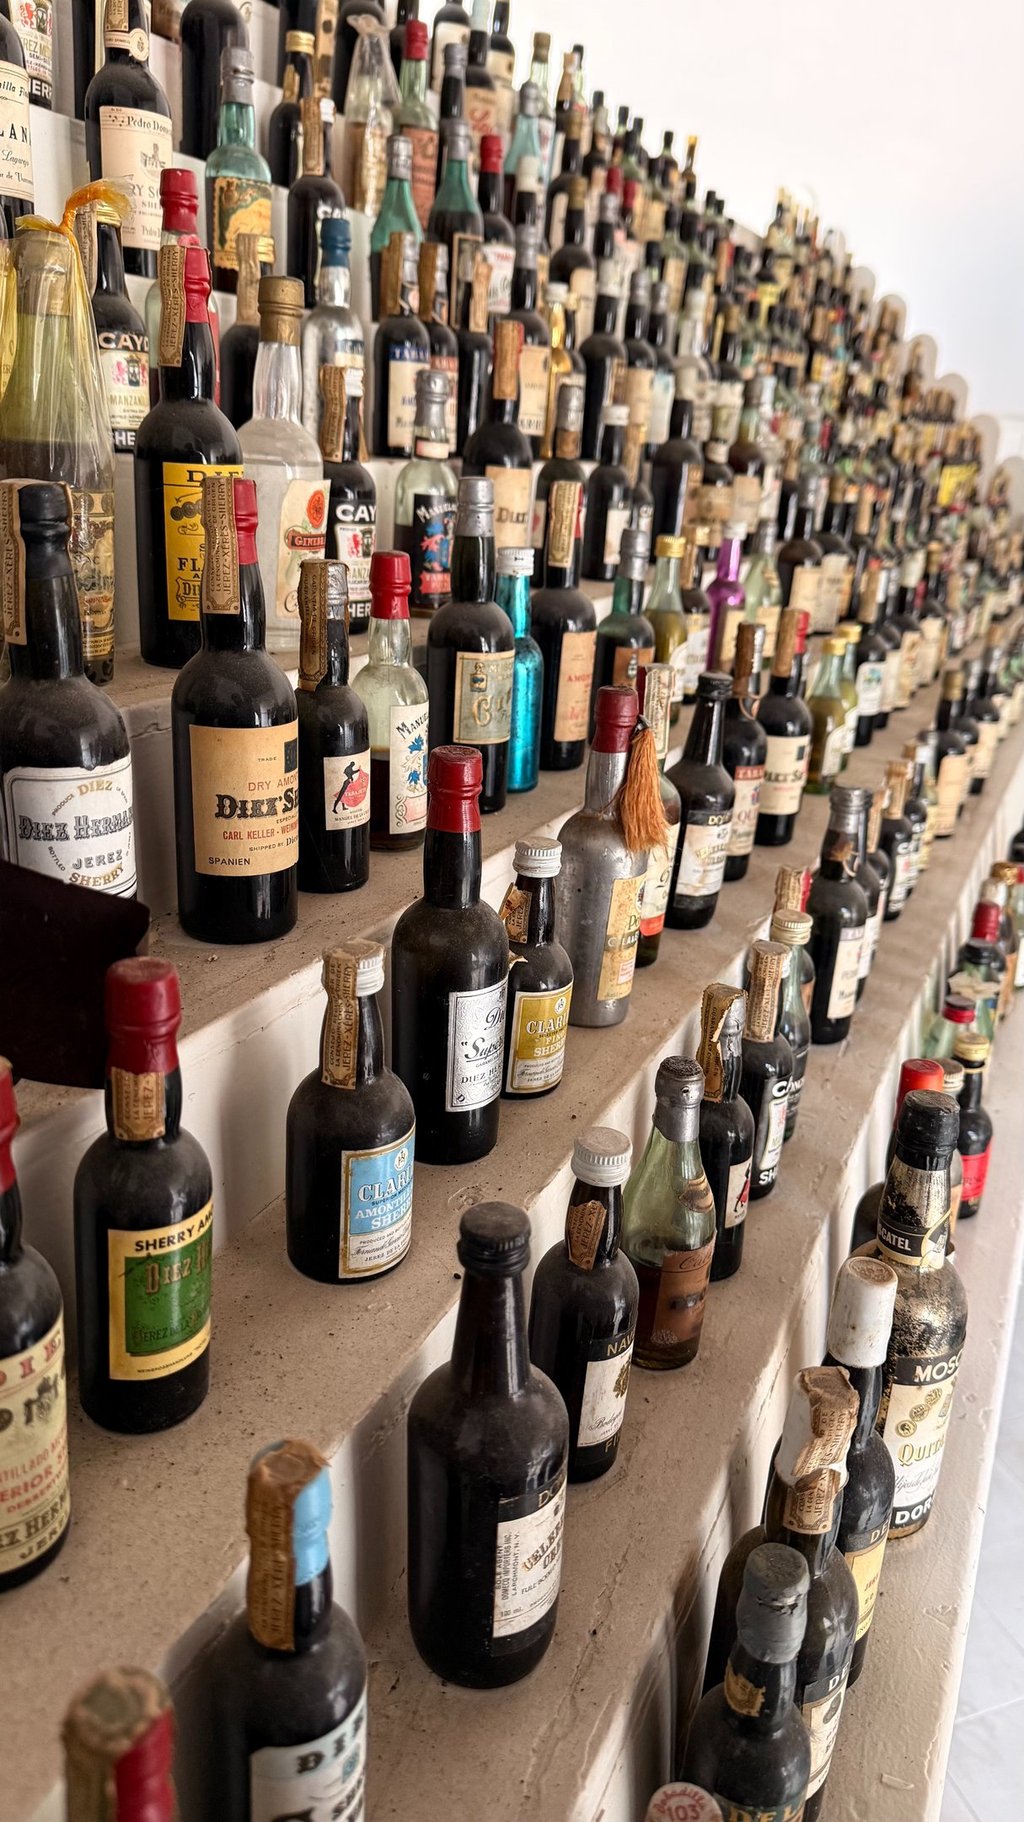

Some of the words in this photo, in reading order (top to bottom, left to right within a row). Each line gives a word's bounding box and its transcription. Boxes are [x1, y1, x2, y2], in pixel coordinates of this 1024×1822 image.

[127, 115, 151, 130] Pedro
[77, 780, 114, 796] DIEZ
[248, 780, 272, 792] DRY
[19, 815, 70, 841] DIEZ
[223, 831, 244, 841] CARL
[247, 828, 275, 840] KELLER
[249, 843, 277, 852] SHIPPED
[72, 849, 123, 870] JEREZ
[208, 857, 251, 866] SPANIEN
[69, 863, 125, 887] SHERRY
[461, 1072, 486, 1084] DIEZ
[135, 1224, 195, 1253] SHERRY
[144, 1256, 192, 1297] DIEZ
[496, 1544, 504, 1569] AGENT
[502, 1545, 512, 1577] IMPORTERS
[501, 1577, 510, 1601] DOMECQ
[666, 1803, 700, 1822] 103
